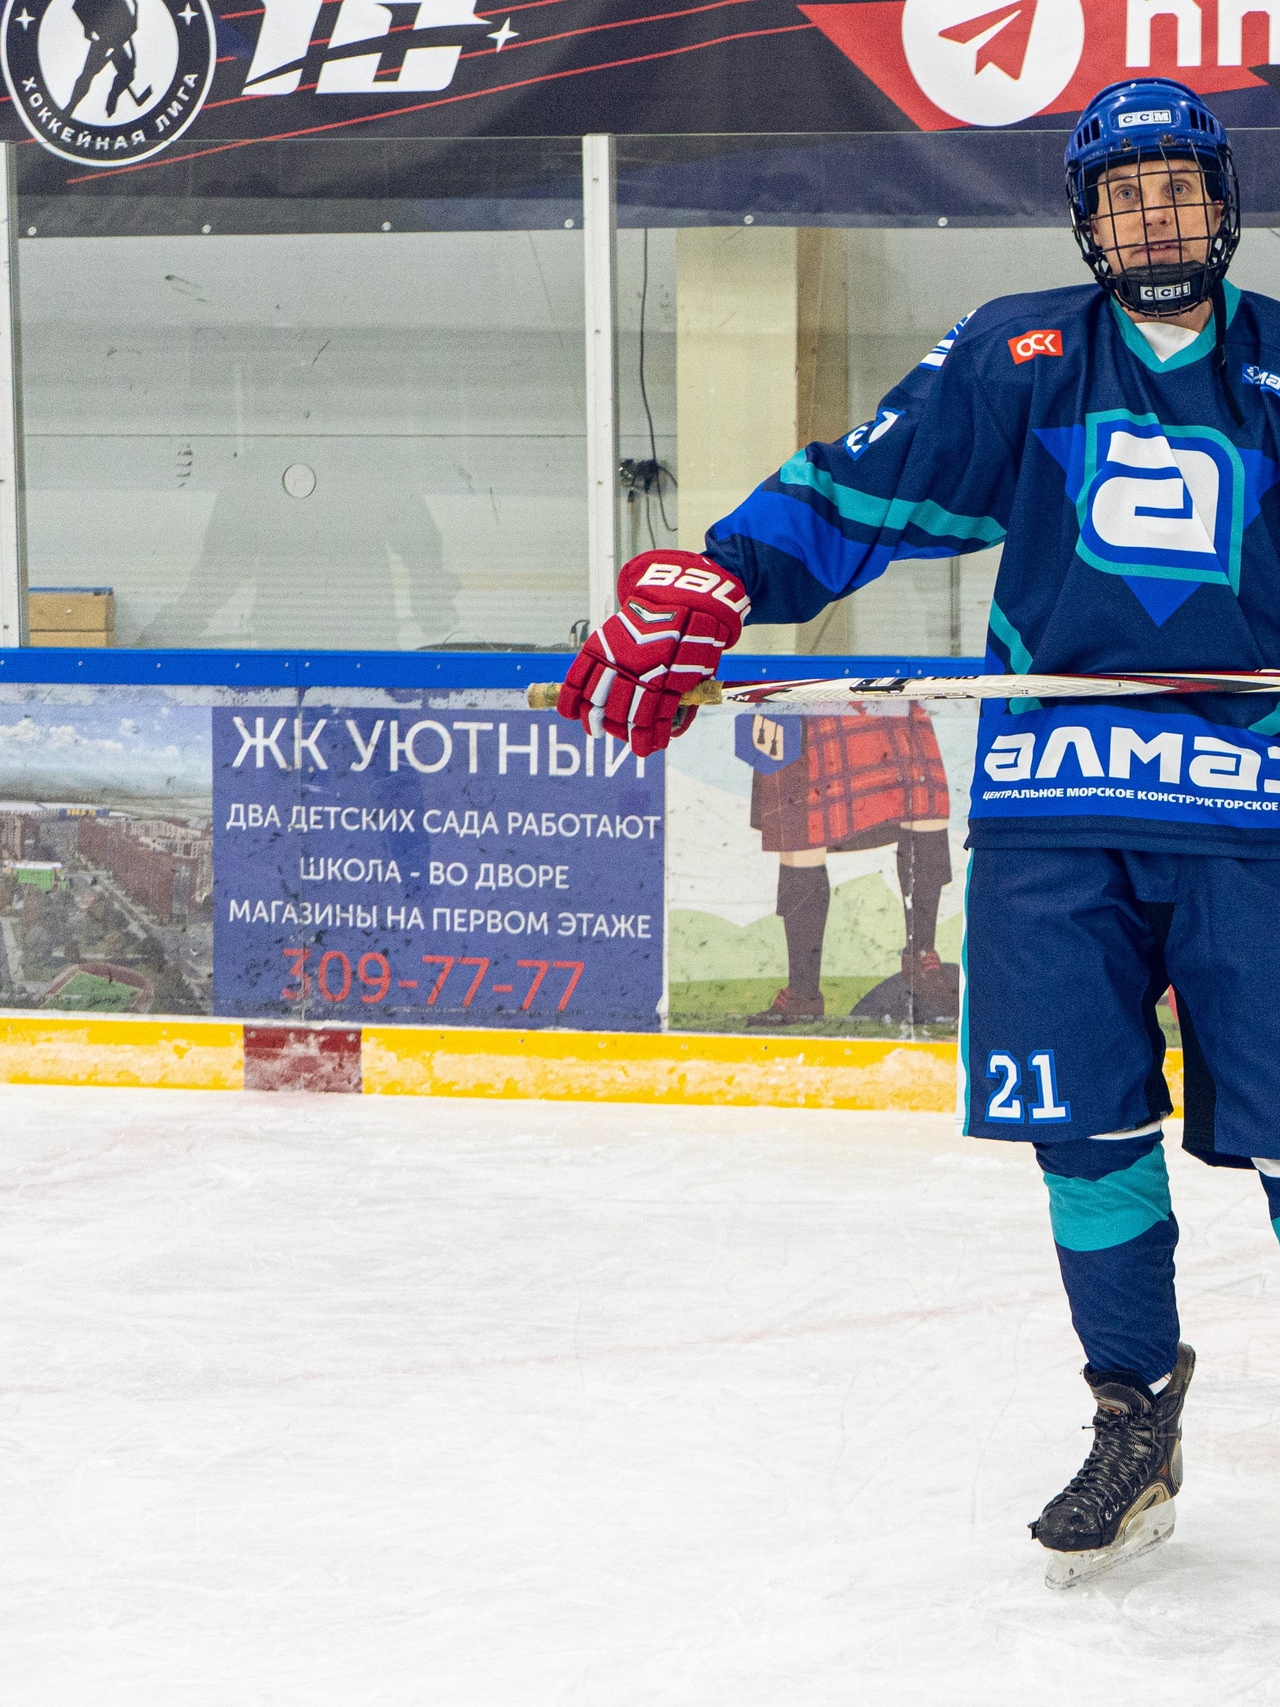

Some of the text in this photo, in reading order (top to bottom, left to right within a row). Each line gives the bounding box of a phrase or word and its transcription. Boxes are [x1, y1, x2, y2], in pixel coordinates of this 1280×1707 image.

[22, 73, 199, 151] ХОККЕЙНАЯ ЛИГА
[1121, 110, 1171, 125] CCM
[1143, 283, 1189, 298] CCM
[232, 716, 329, 771] ЖК
[982, 788, 1064, 801] ЦЕНТРАЛЬНОЕ
[1066, 787, 1135, 799] МОРСКОЕ
[1137, 790, 1279, 812] КОНСТРУКТОРСКОЕ
[226, 802, 662, 840] ДВА ДЕТСКИХ САДА РАБОТАЮТ
[300, 857, 402, 883] ШКОЛА
[430, 861, 469, 886] ВО
[475, 864, 569, 891] ДВОРЕ
[228, 899, 652, 939] МАГАЗИНЫ НА ПЕРВОМ ЭТАЖЕ
[281, 947, 586, 1012] 309-77-77
[987, 1052, 1069, 1120] 21
